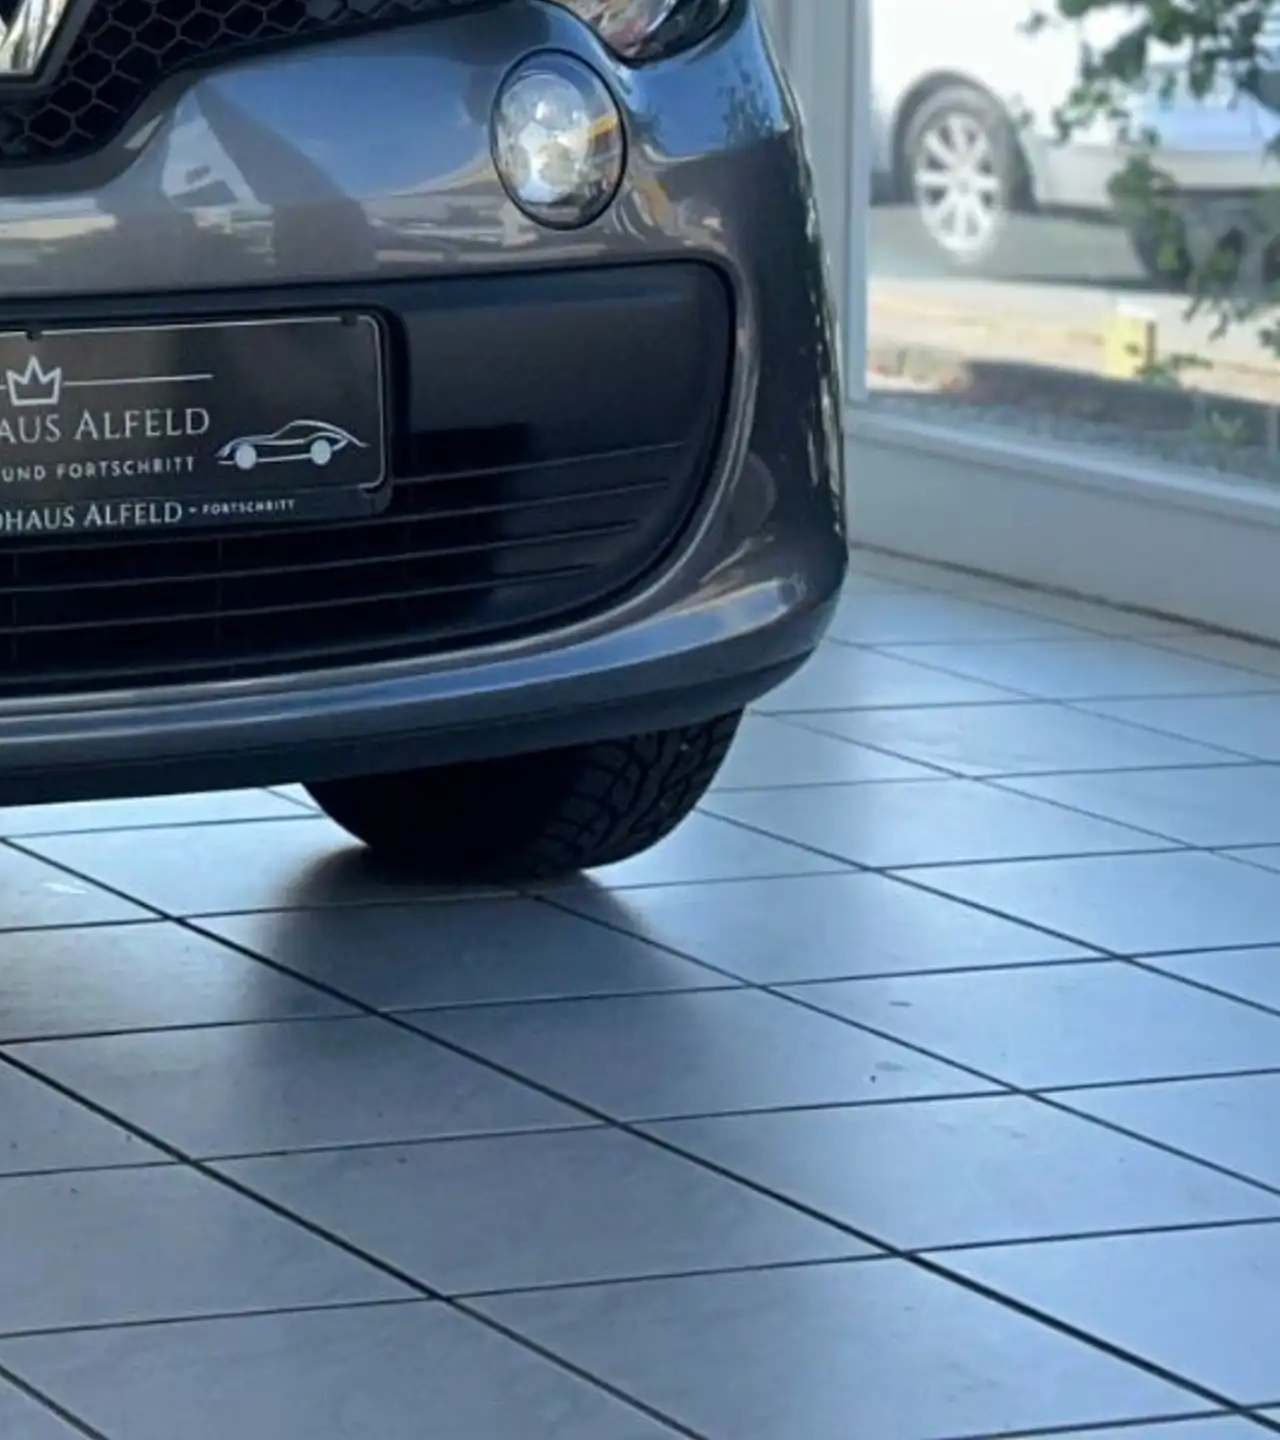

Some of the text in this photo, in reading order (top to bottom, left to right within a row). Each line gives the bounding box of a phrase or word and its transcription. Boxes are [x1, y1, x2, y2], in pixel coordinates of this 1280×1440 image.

[73, 407, 210, 443] ALFELD
[2, 464, 46, 483] UND
[56, 455, 195, 481] FORTSCHRITT
[82, 500, 182, 528] ALFELD
[201, 498, 297, 516] FORTSCHRITT
